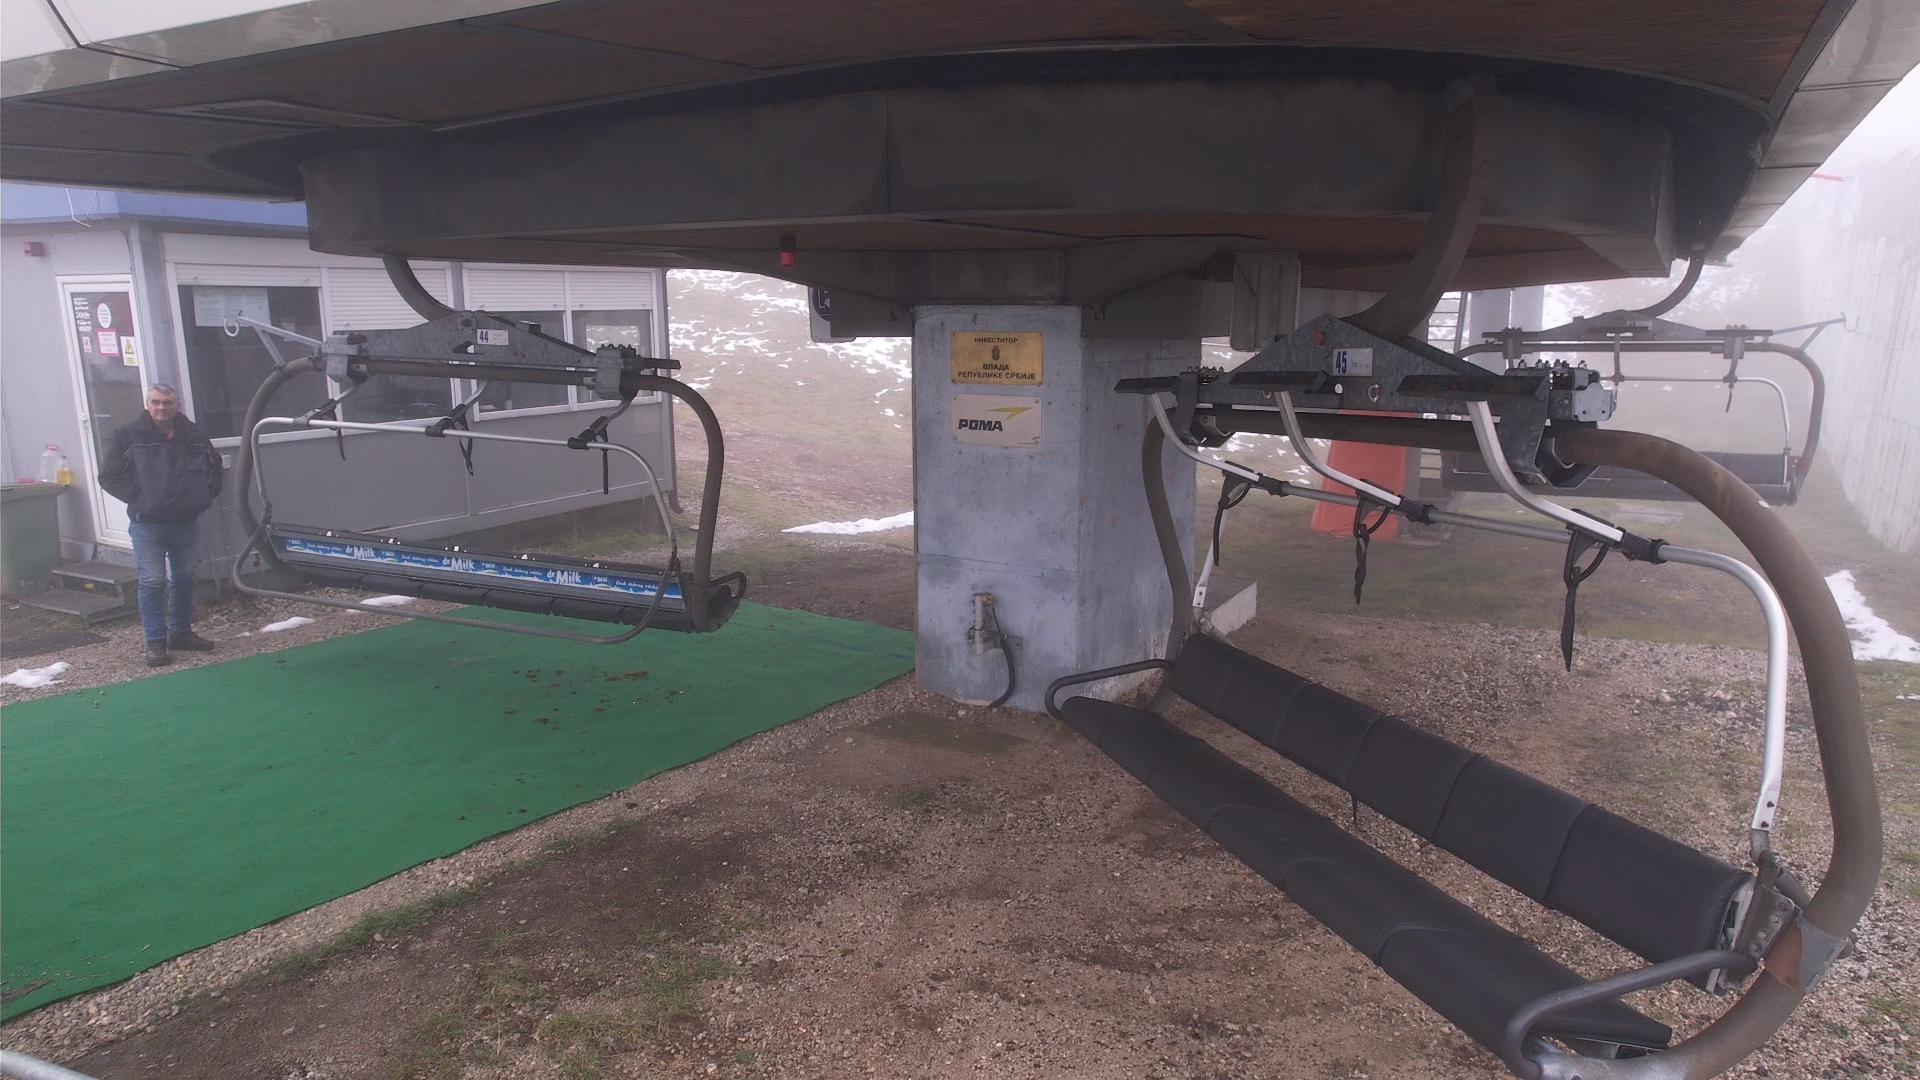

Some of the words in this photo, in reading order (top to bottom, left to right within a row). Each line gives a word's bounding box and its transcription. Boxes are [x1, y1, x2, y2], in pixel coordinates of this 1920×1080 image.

[480, 331, 488, 343] 44
[982, 363, 1010, 371] ВЛАДА
[1336, 351, 1347, 374] 45
[957, 371, 1003, 379] РЕПУБЛИКЕ
[1005, 372, 1036, 380] СРБИЈЕ
[958, 418, 1003, 431] POMA
[345, 545, 353, 554] dr
[353, 546, 376, 558] Milk
[442, 557, 450, 565] dr
[450, 557, 475, 570] Milk
[546, 569, 556, 578] dr
[556, 570, 582, 584] Milk
